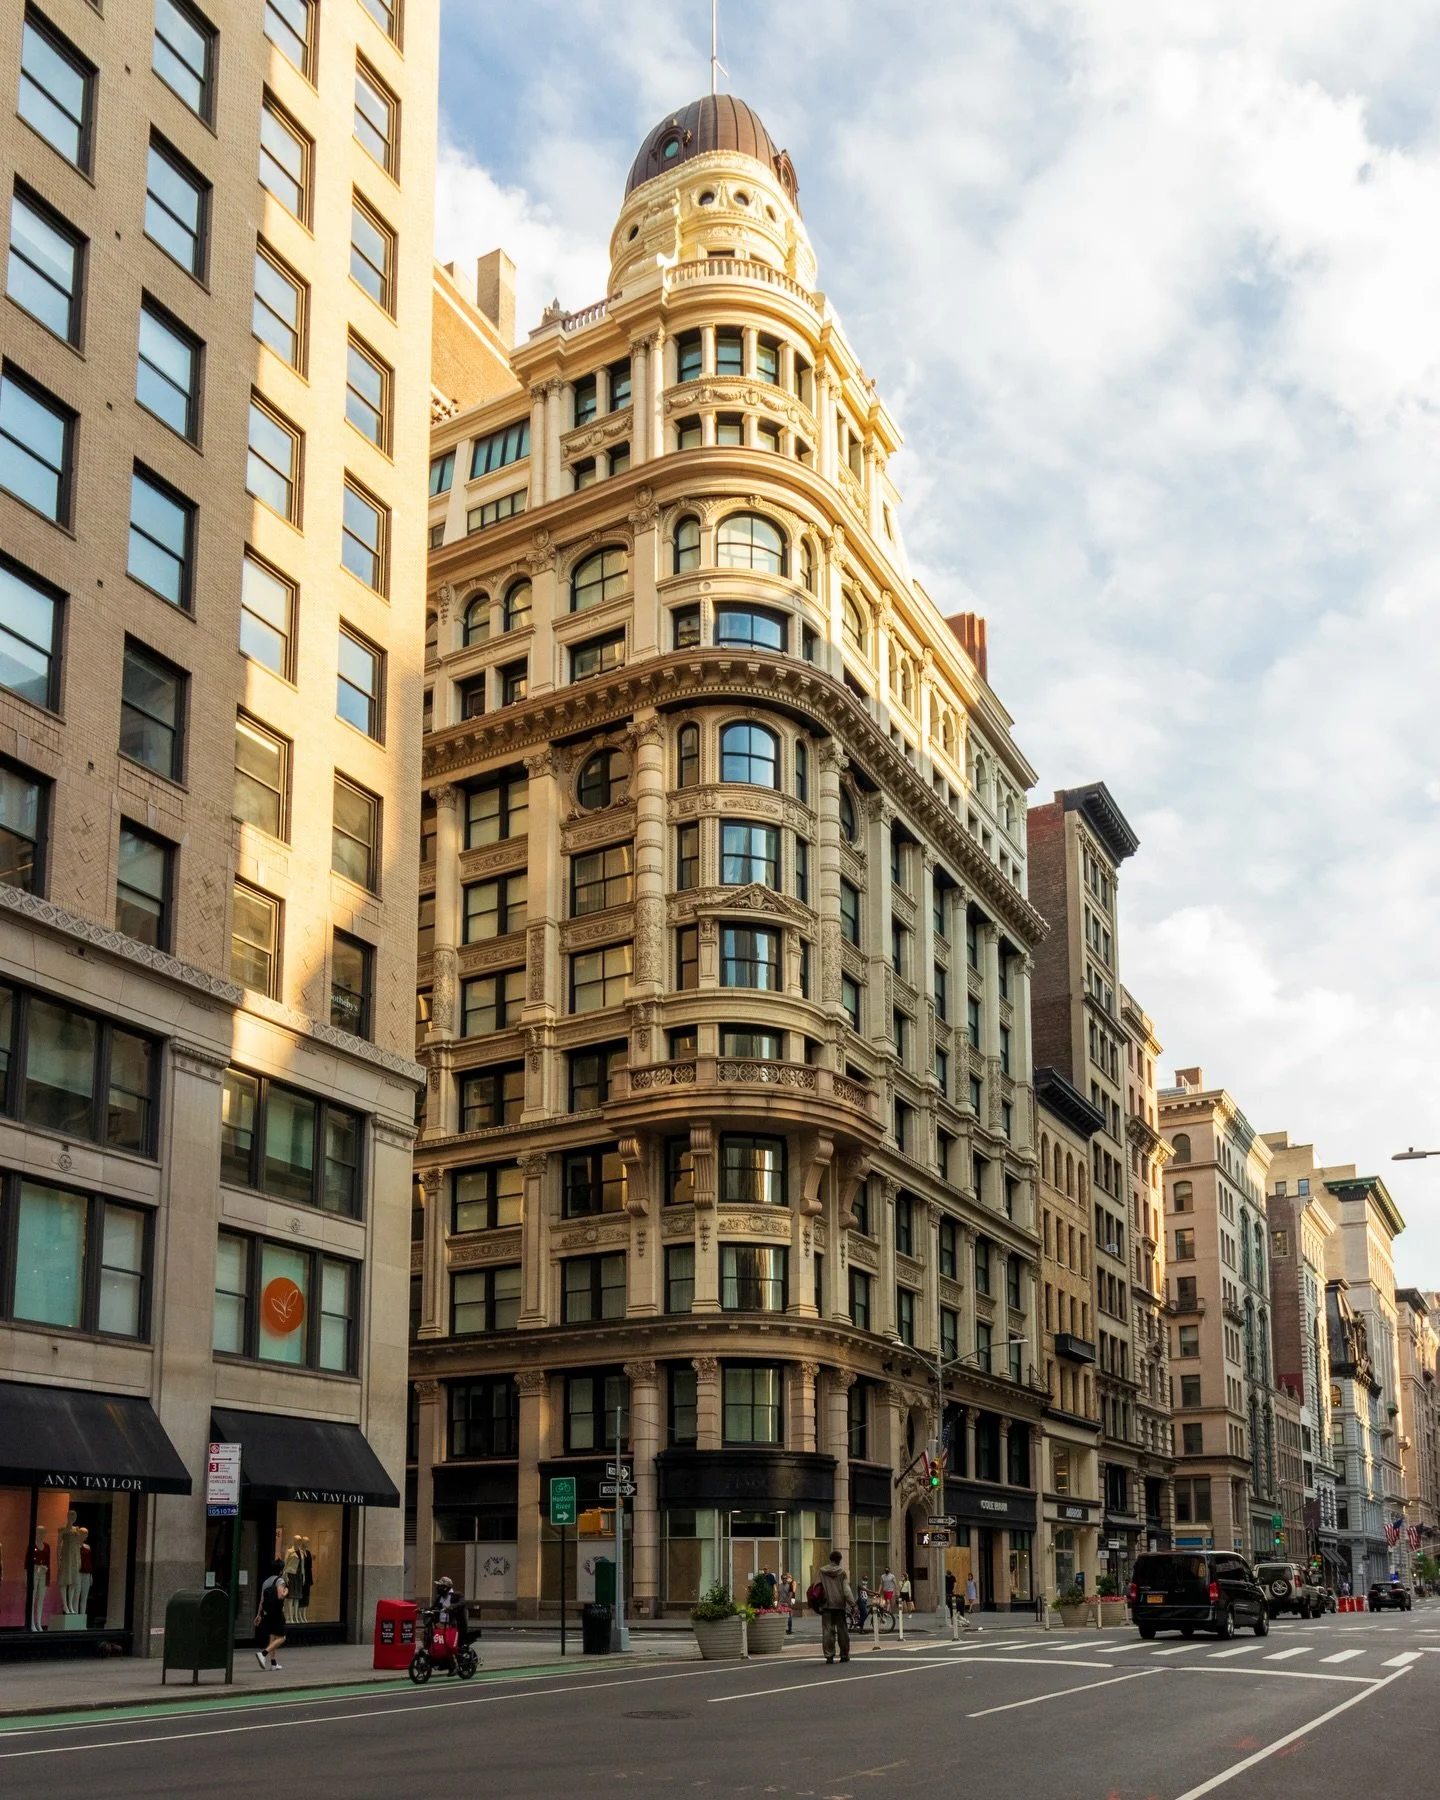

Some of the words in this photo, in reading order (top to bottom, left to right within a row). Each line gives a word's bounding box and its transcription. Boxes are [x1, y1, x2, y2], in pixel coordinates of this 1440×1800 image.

[212, 1463, 218, 1472] 3
[44, 1474, 78, 1486] ANN
[82, 1476, 142, 1490] TAYLOR
[294, 1491, 319, 1500] ANN
[321, 1492, 364, 1504] TAYLOR
[1065, 1507, 1083, 1519] MIRROR
